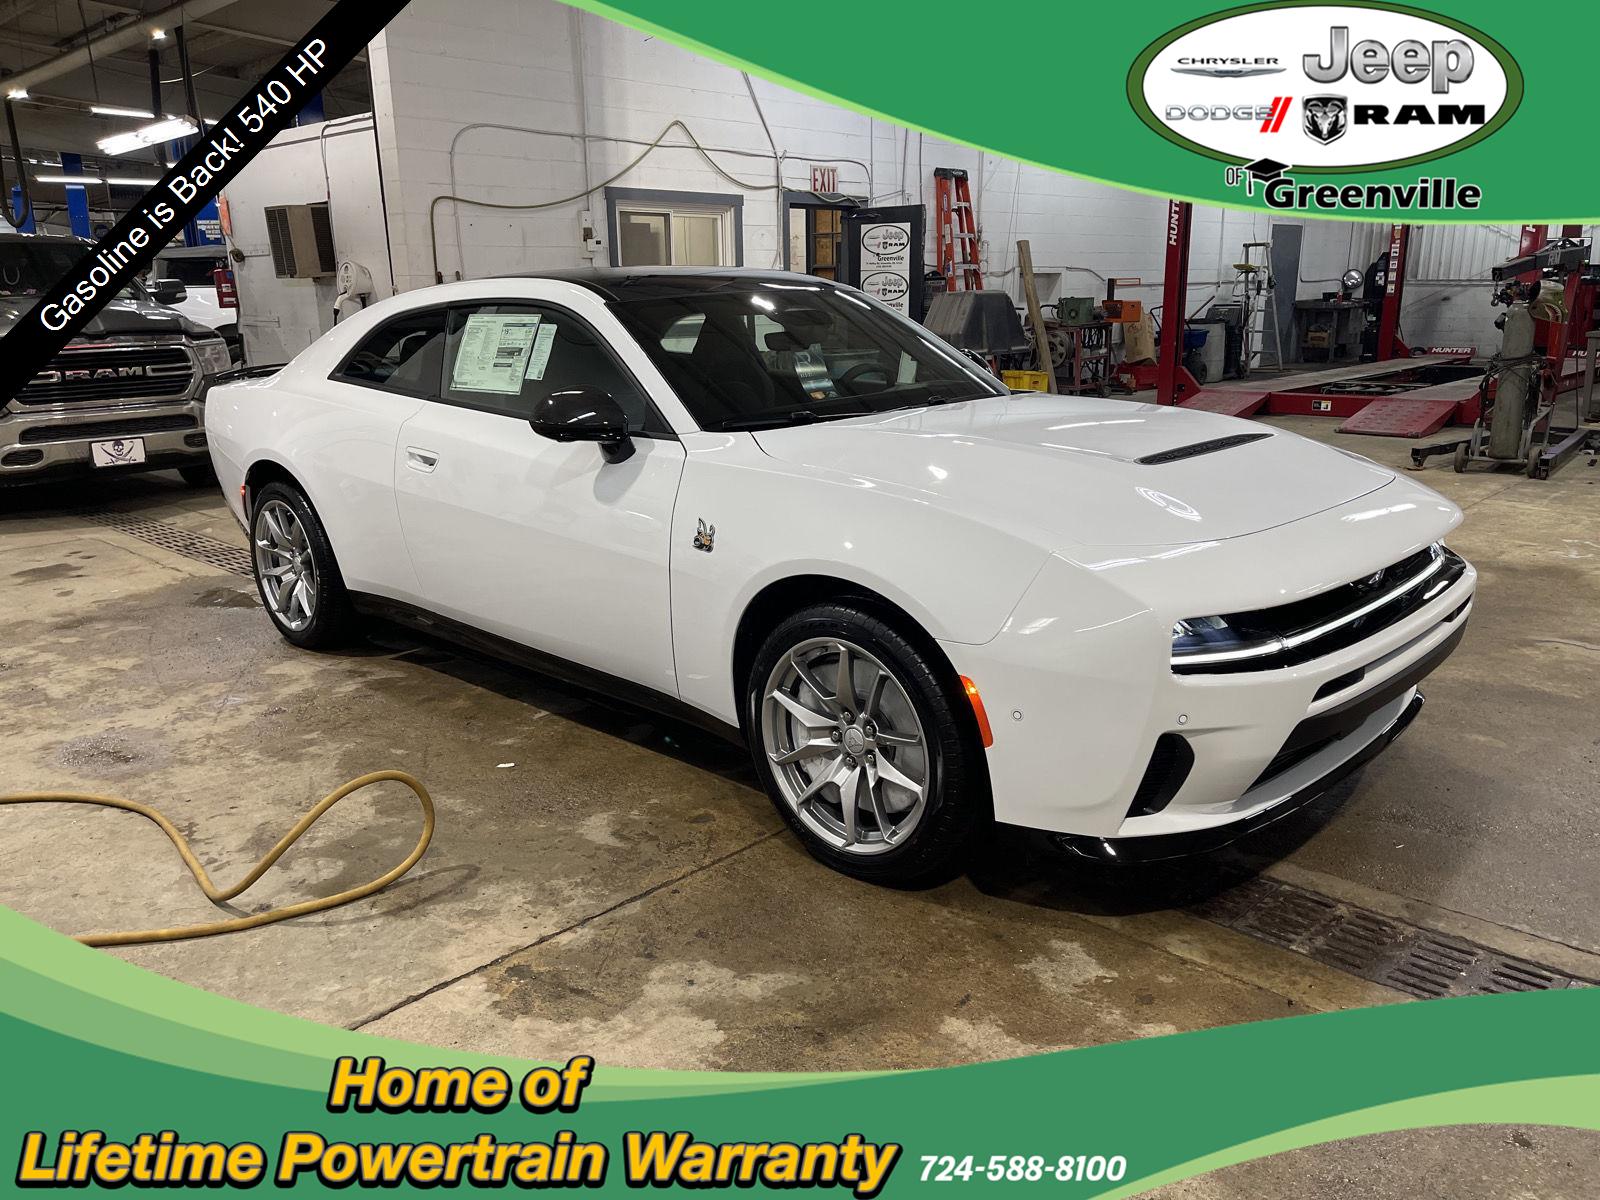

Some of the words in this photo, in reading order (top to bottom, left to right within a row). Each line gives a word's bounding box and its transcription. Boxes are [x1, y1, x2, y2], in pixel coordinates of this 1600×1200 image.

[812, 167, 837, 193] EXIT
[882, 229, 904, 241] Jeep
[65, 366, 143, 381] RAM
